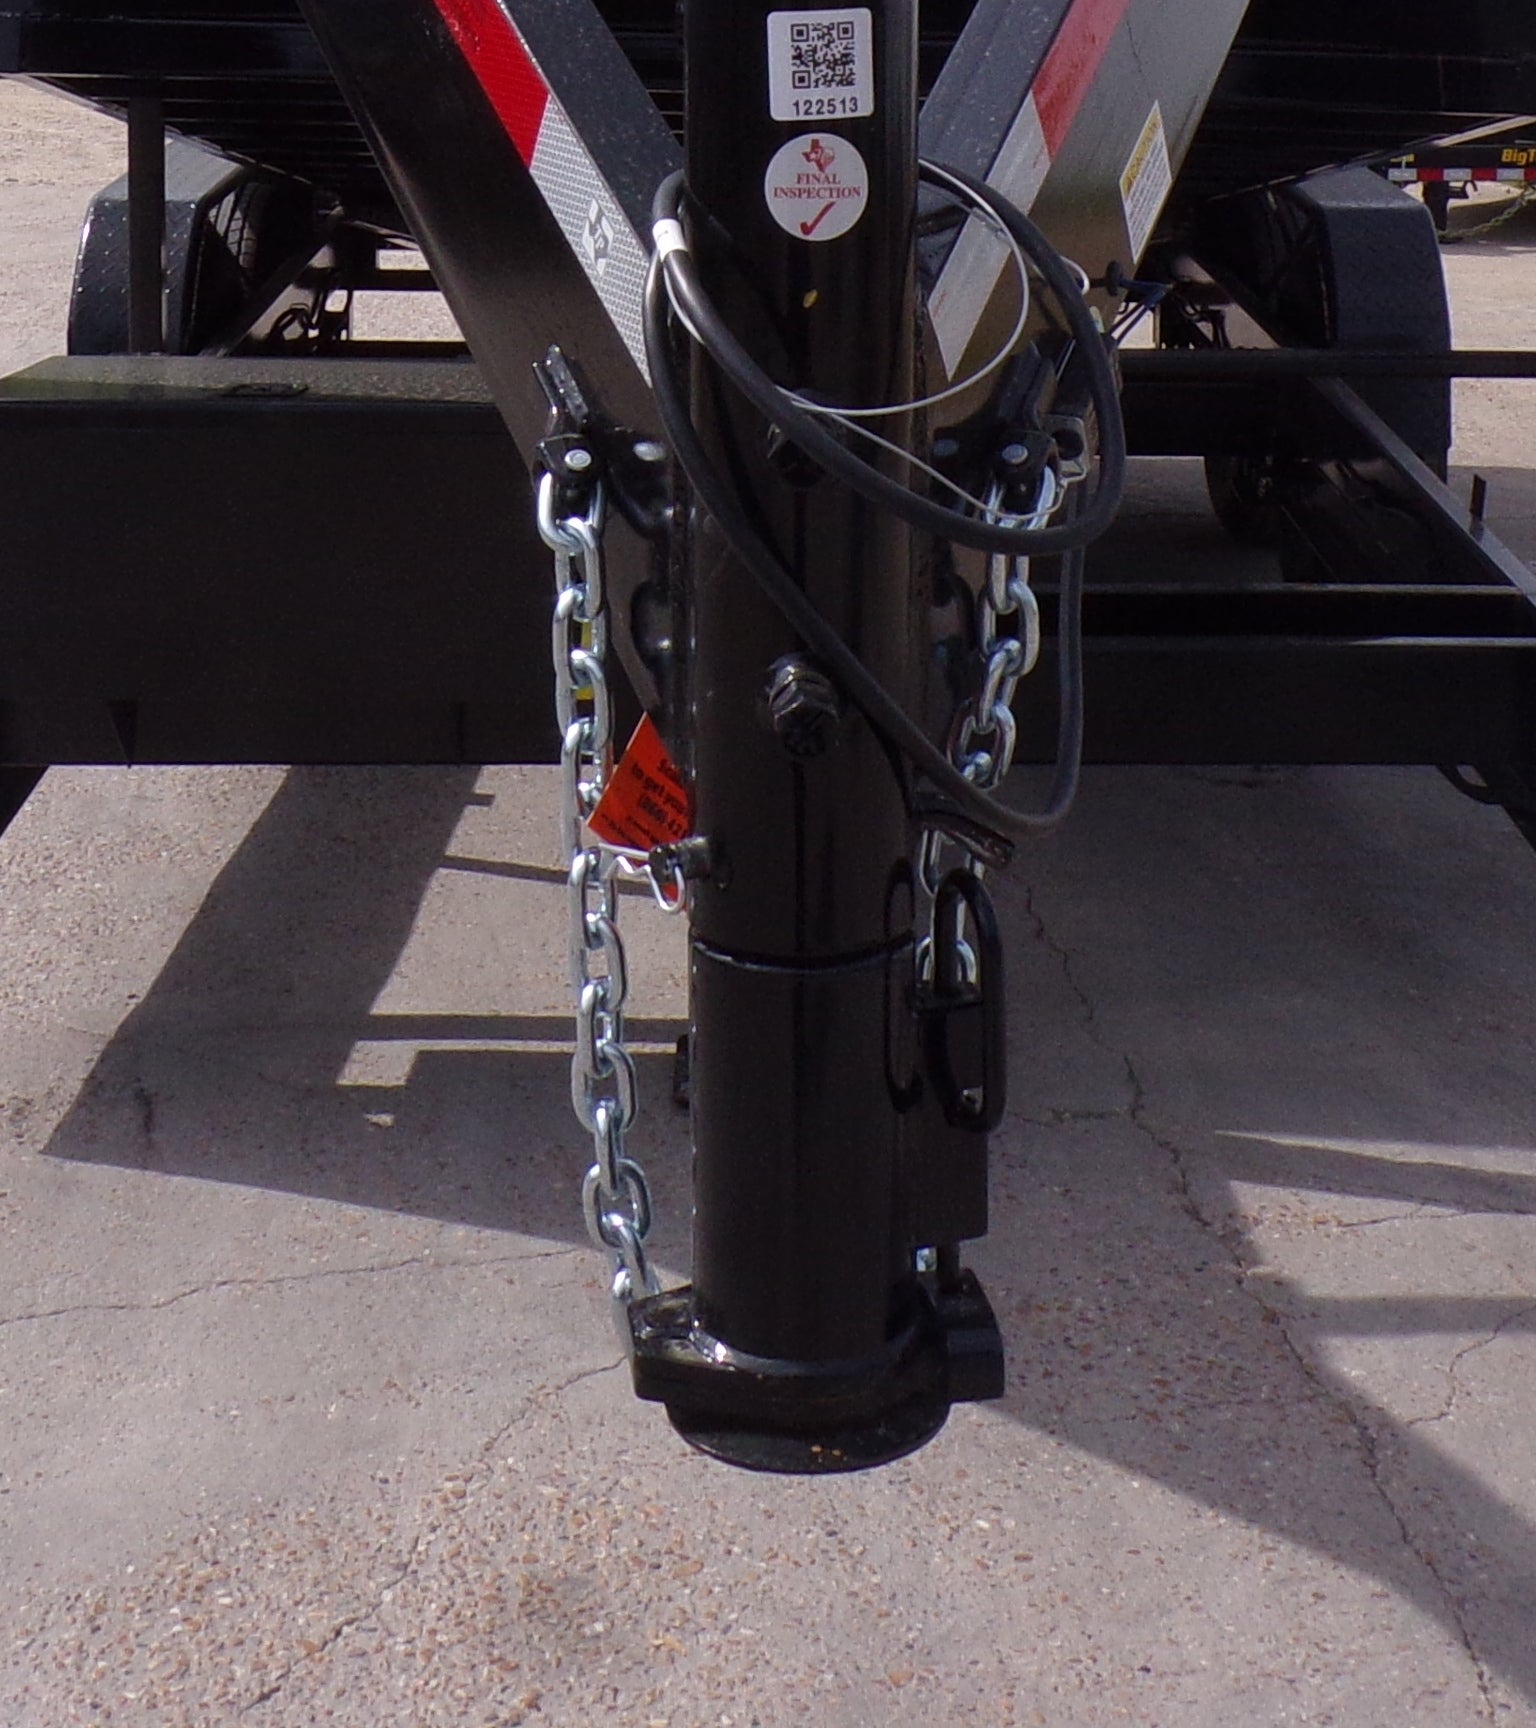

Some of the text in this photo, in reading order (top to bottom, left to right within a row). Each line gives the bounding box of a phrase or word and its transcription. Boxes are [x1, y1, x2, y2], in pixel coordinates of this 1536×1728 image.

[792, 96, 859, 117] 122513
[795, 173, 841, 186] FINAL
[773, 185, 862, 200] INSPECTION
